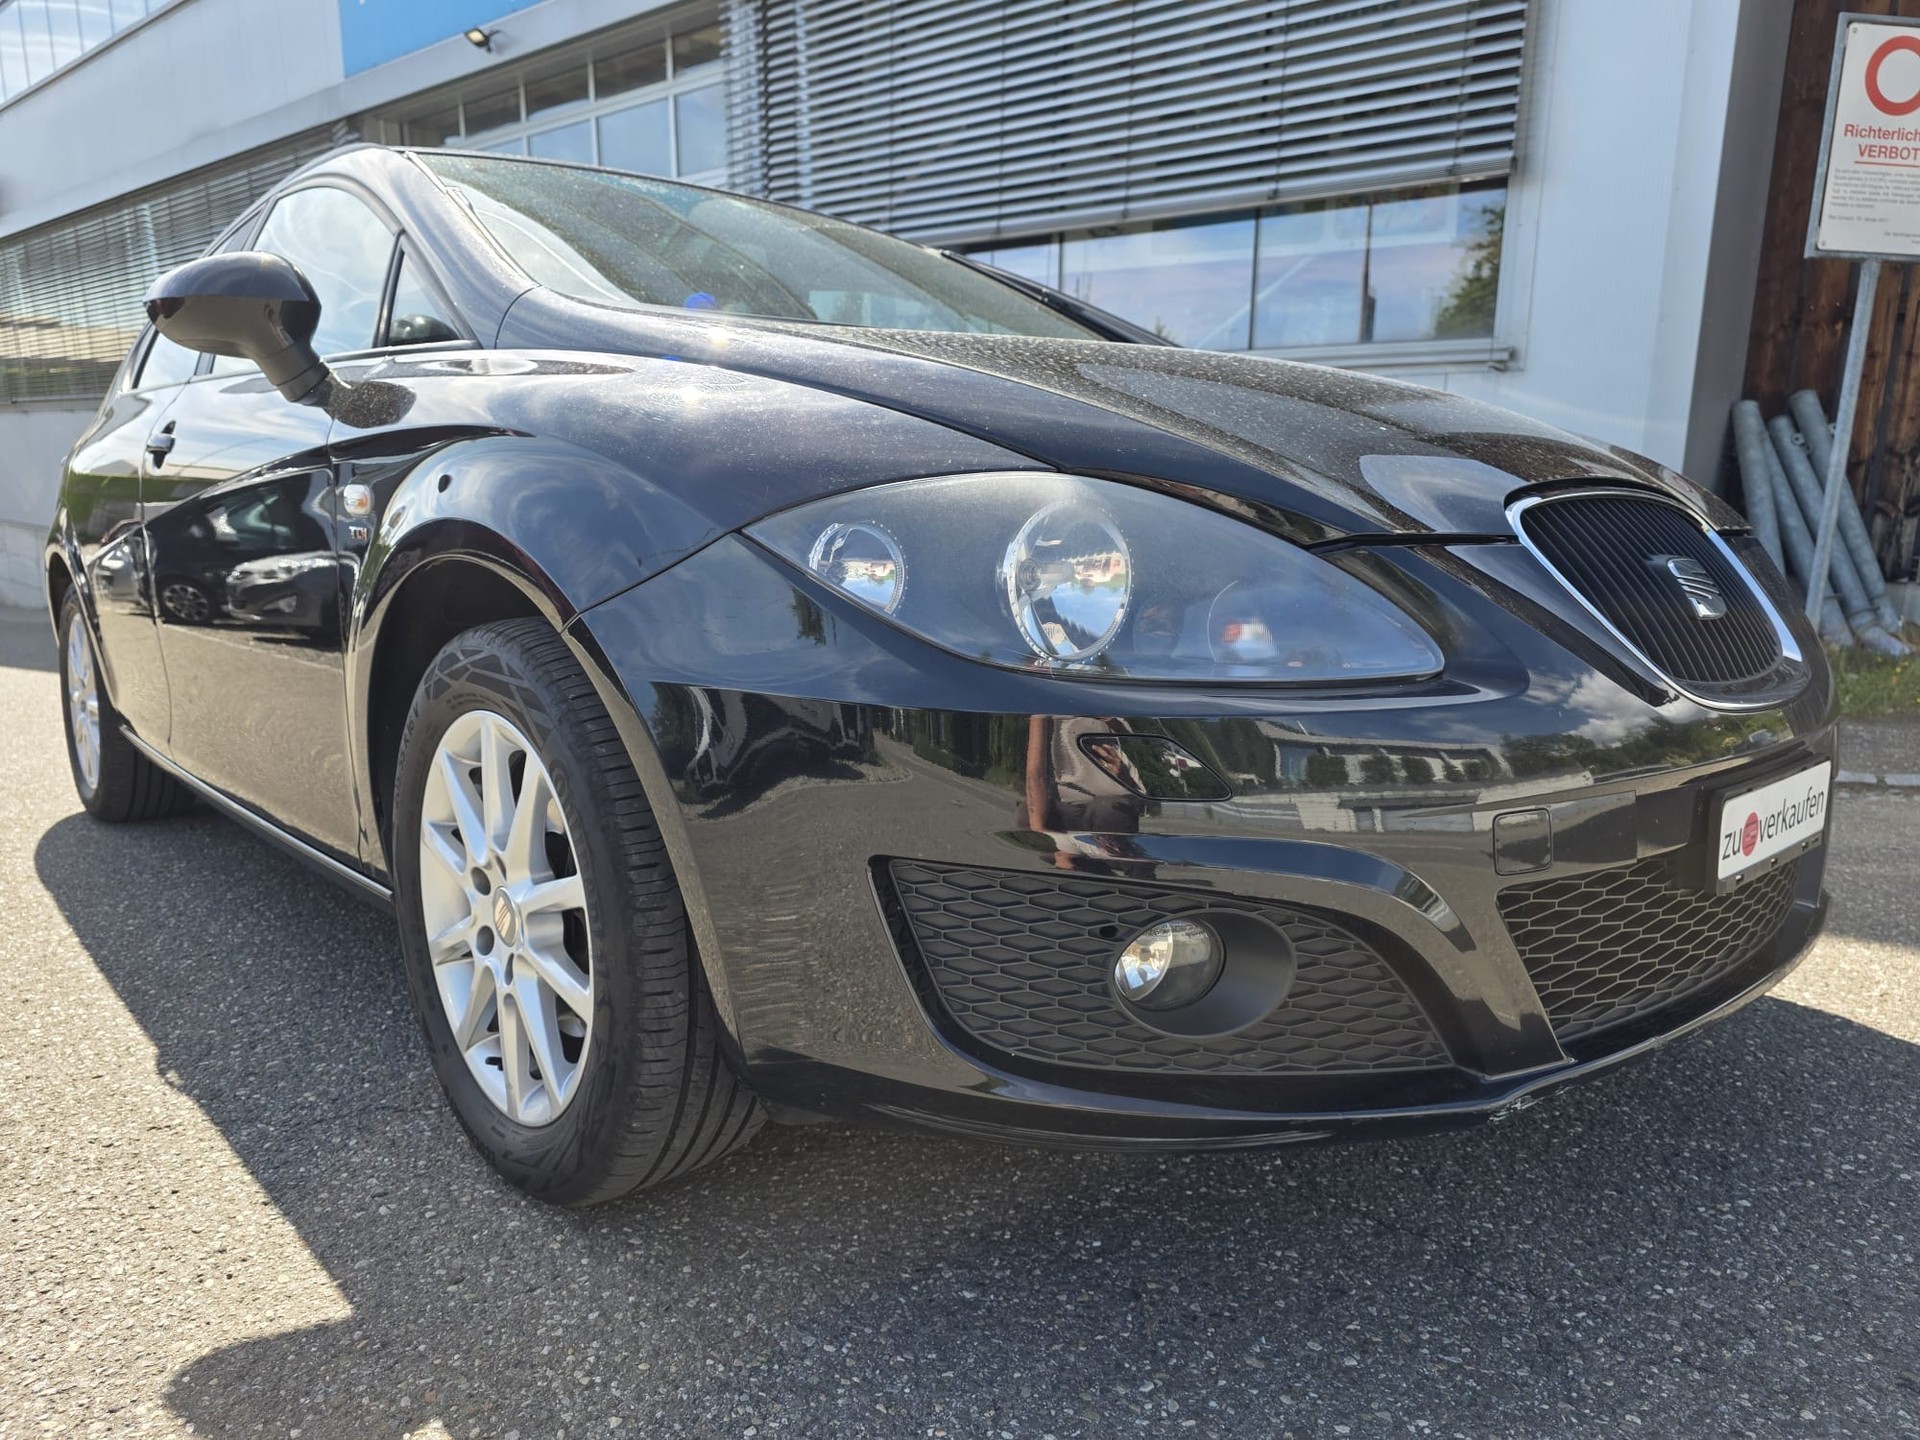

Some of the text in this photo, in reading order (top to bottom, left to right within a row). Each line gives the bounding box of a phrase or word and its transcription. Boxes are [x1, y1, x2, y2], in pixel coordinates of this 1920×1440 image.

[1858, 144, 1920, 161] VERBOT
[1721, 828, 1743, 860] zu
[1759, 786, 1824, 843] verkaufen
